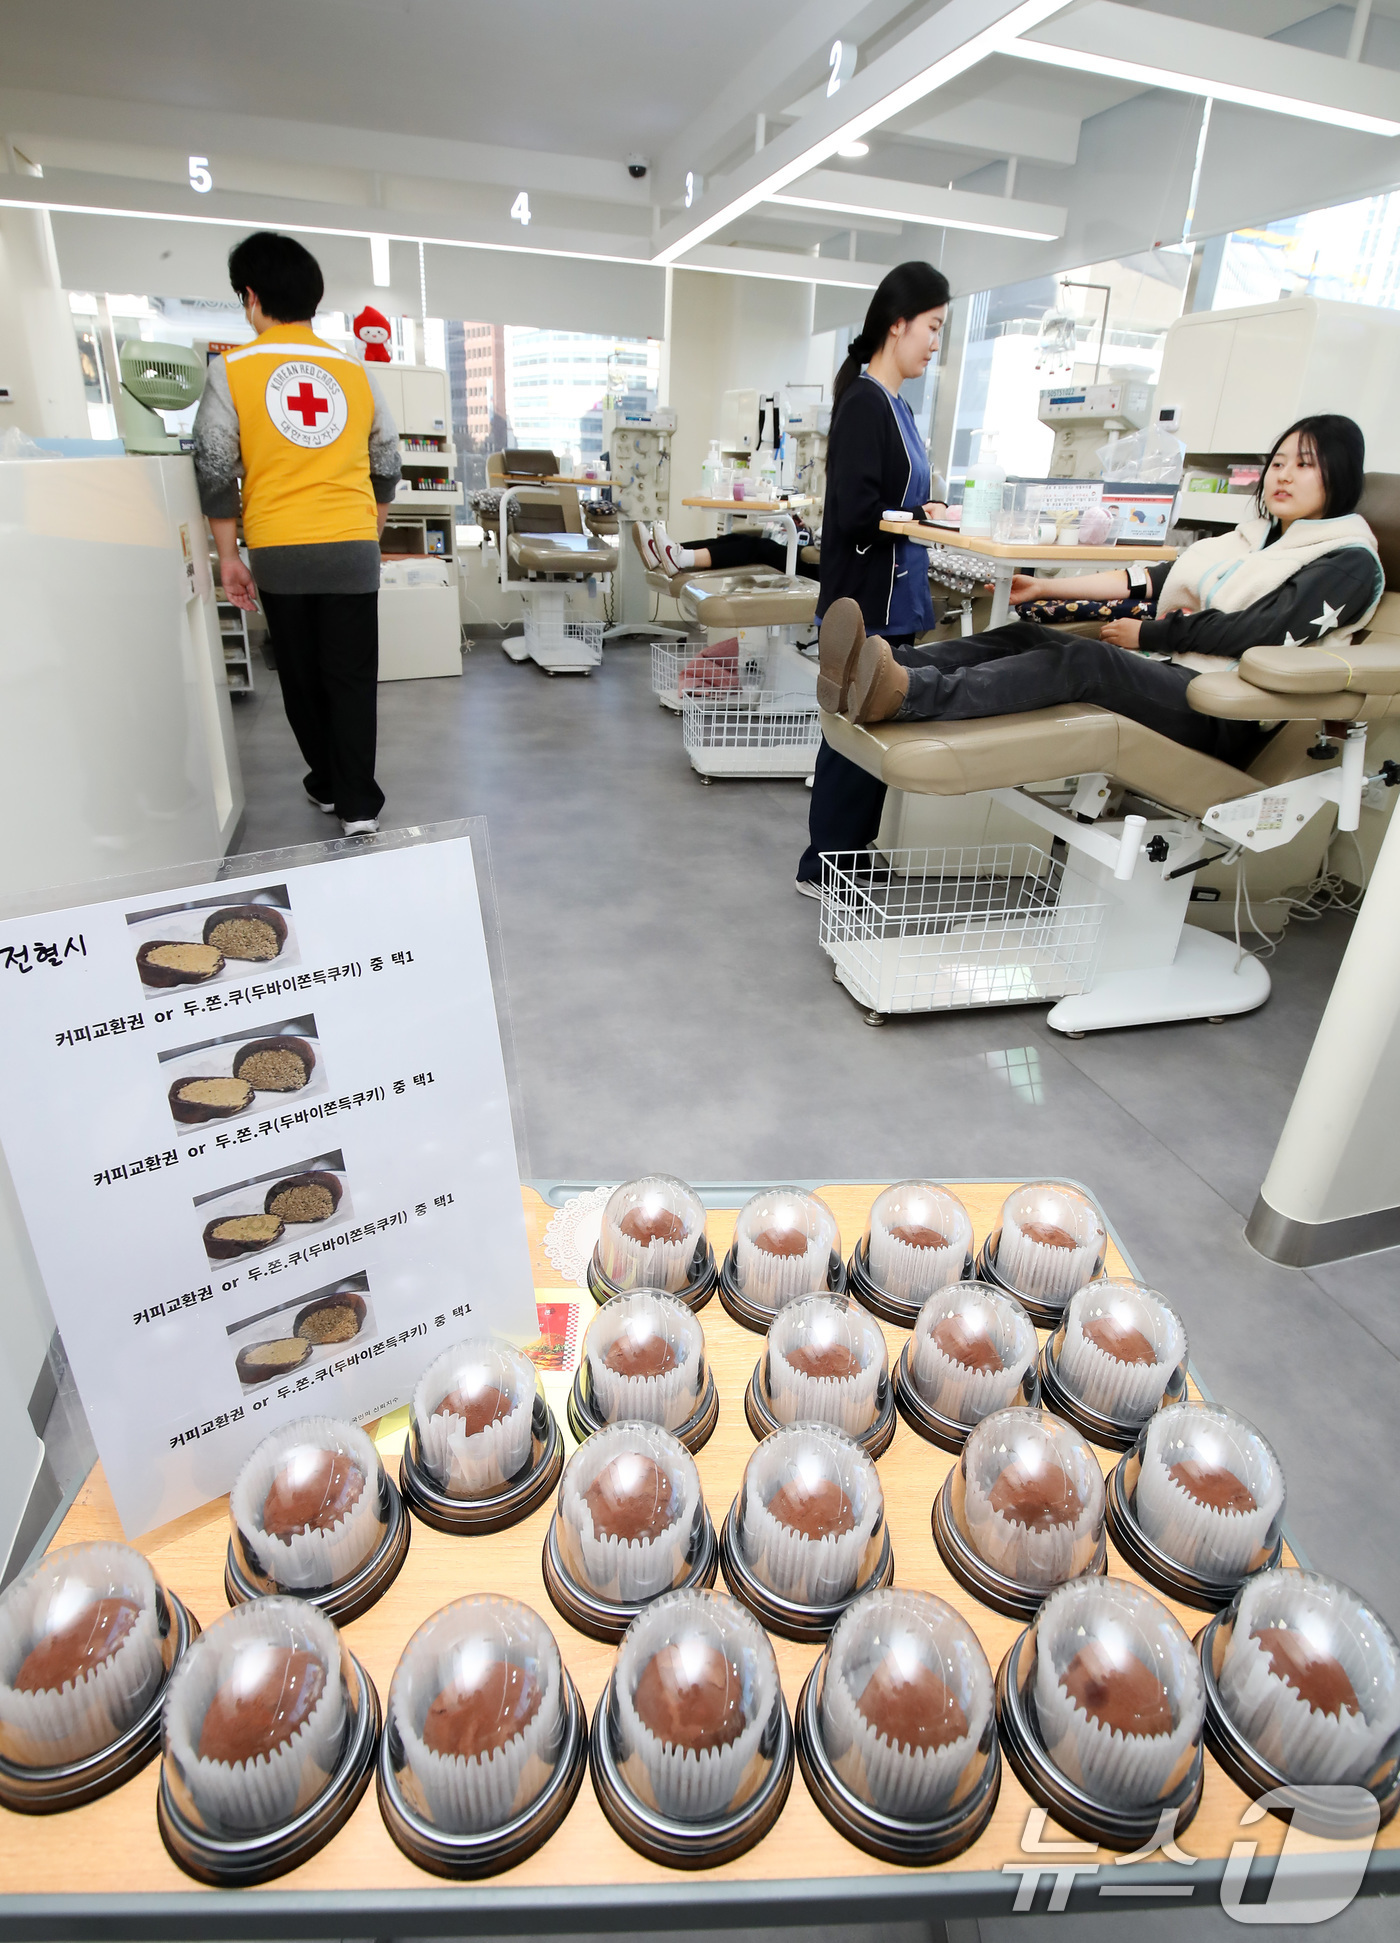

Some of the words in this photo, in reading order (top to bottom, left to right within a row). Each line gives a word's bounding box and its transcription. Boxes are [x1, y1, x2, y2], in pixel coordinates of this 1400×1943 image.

[826, 39, 848, 99] 2
[188, 155, 213, 194] 5
[685, 171, 698, 208] 3
[510, 191, 532, 226] 4
[270, 364, 299, 391] KOREAN
[299, 363, 316, 377] RED
[315, 369, 341, 395] CROSS
[280, 420, 340, 446] 대한적십자사
[0, 934, 88, 974] 전혈시
[55, 1012, 146, 1047] 커피교환권
[154, 1008, 174, 1024] or
[183, 961, 362, 1017] 두.쫀.쿠(두바이쫀득쿠키)
[369, 956, 384, 972] 중
[391, 950, 415, 966] 택1
[93, 1148, 180, 1187] 커피교환권
[187, 1143, 207, 1158] or
[215, 1086, 386, 1149] 두.쫀.쿠(두바이쫀득쿠키)
[392, 1079, 407, 1095] 중
[412, 1071, 435, 1087] 택1
[132, 1284, 214, 1326] 커피교환권
[221, 1277, 240, 1292] or
[247, 1210, 408, 1282] 두.쫀.쿠(두바이쫀득쿠키)
[414, 1202, 428, 1217] 중
[433, 1192, 455, 1208] 택1
[169, 1405, 246, 1449] 커피교환권
[252, 1396, 270, 1412] or
[277, 1322, 429, 1399] 두.쫀.쿠(두바이쫀득쿠키)
[433, 1313, 447, 1328] 중
[451, 1302, 473, 1318] 택1
